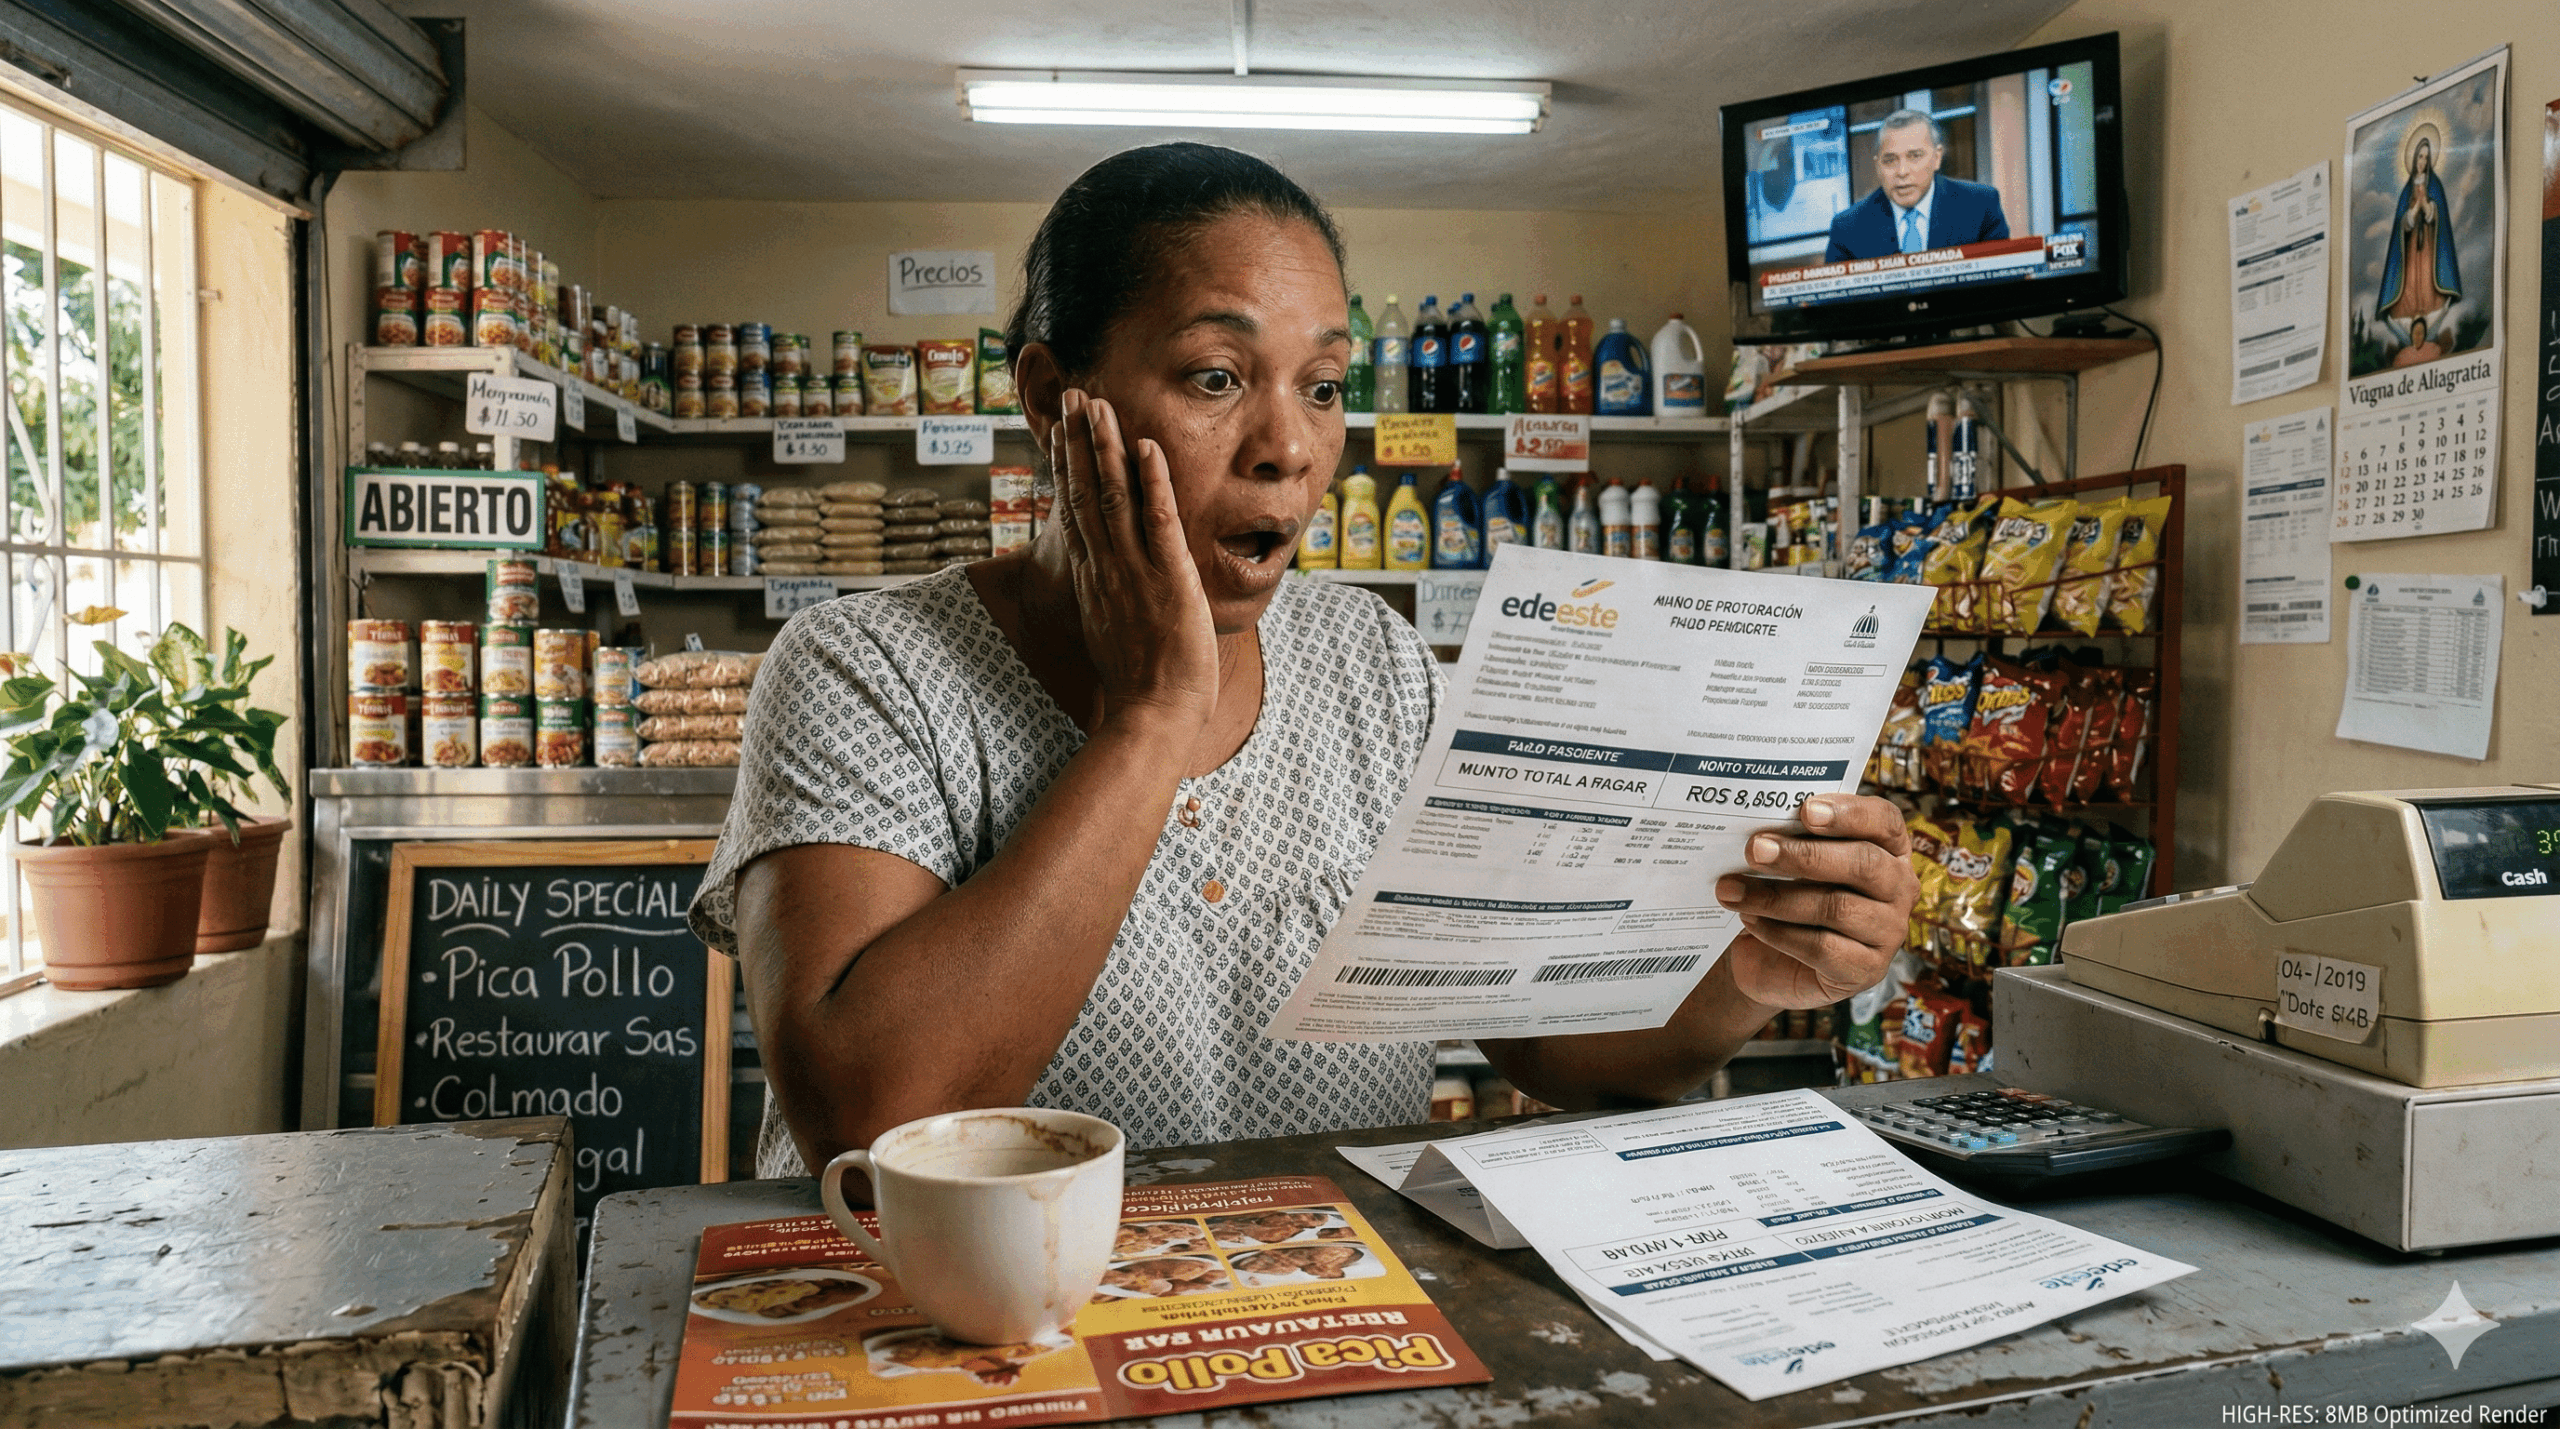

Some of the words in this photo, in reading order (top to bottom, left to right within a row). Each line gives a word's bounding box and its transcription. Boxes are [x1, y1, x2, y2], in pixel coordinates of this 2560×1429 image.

[900, 256, 984, 286] Precios
[2397, 374, 2414, 396] de
[2401, 425, 2405, 436] 1
[2419, 422, 2425, 434] 2
[2438, 417, 2444, 430] 3
[2457, 414, 2464, 426] 4
[2478, 410, 2484, 423] 5
[2361, 448, 2367, 460] 6
[2380, 445, 2386, 456] 7
[2399, 442, 2405, 454] 8
[2418, 439, 2425, 450] 9
[2435, 435, 2447, 447] 10
[2455, 432, 2466, 444] 11
[2476, 429, 2486, 441] 12
[2358, 464, 2369, 476] 13
[2377, 462, 2387, 473] 14
[2396, 459, 2407, 471] 15
[2415, 456, 2427, 467] 16
[2435, 453, 2446, 465] 17
[2454, 450, 2466, 463] 18
[2474, 447, 2486, 459] 19
[2356, 481, 2369, 493] 20
[2375, 479, 2386, 490] 21
[2394, 476, 2406, 488] 22
[2414, 473, 2426, 486] 23
[2433, 471, 2445, 483] 24
[2452, 468, 2465, 480] 25
[2472, 465, 2484, 478] 26
[359, 482, 532, 536] ABIERTO
[2356, 497, 2367, 509] 27
[2374, 496, 2385, 507] 21
[2393, 493, 2405, 505] 22
[2413, 491, 2425, 503] 23
[2432, 489, 2444, 501] 24
[2451, 486, 2463, 498] 25
[2470, 484, 2482, 496] 26
[2355, 514, 2365, 526] 27
[2373, 512, 2385, 524] 28
[2392, 511, 2405, 522] 29
[2412, 508, 2424, 520] 30
[1501, 593, 1619, 629] edeeste
[1695, 599, 1714, 613] DE
[1715, 600, 1804, 620] PROTORACIÓN
[1458, 761, 1519, 782] MUNTO
[1521, 769, 1573, 788] TOTAL
[1575, 775, 1588, 788] A
[1686, 785, 1731, 806] ROS
[2501, 868, 2548, 887] Cash
[441, 945, 540, 1001] Pica
[553, 942, 675, 998] Pollo
[430, 1015, 612, 1062] Restaurar
[625, 1015, 698, 1057] Sas
[1299, 1334, 1447, 1372] Pica
[1123, 1346, 1297, 1394] Pollo
